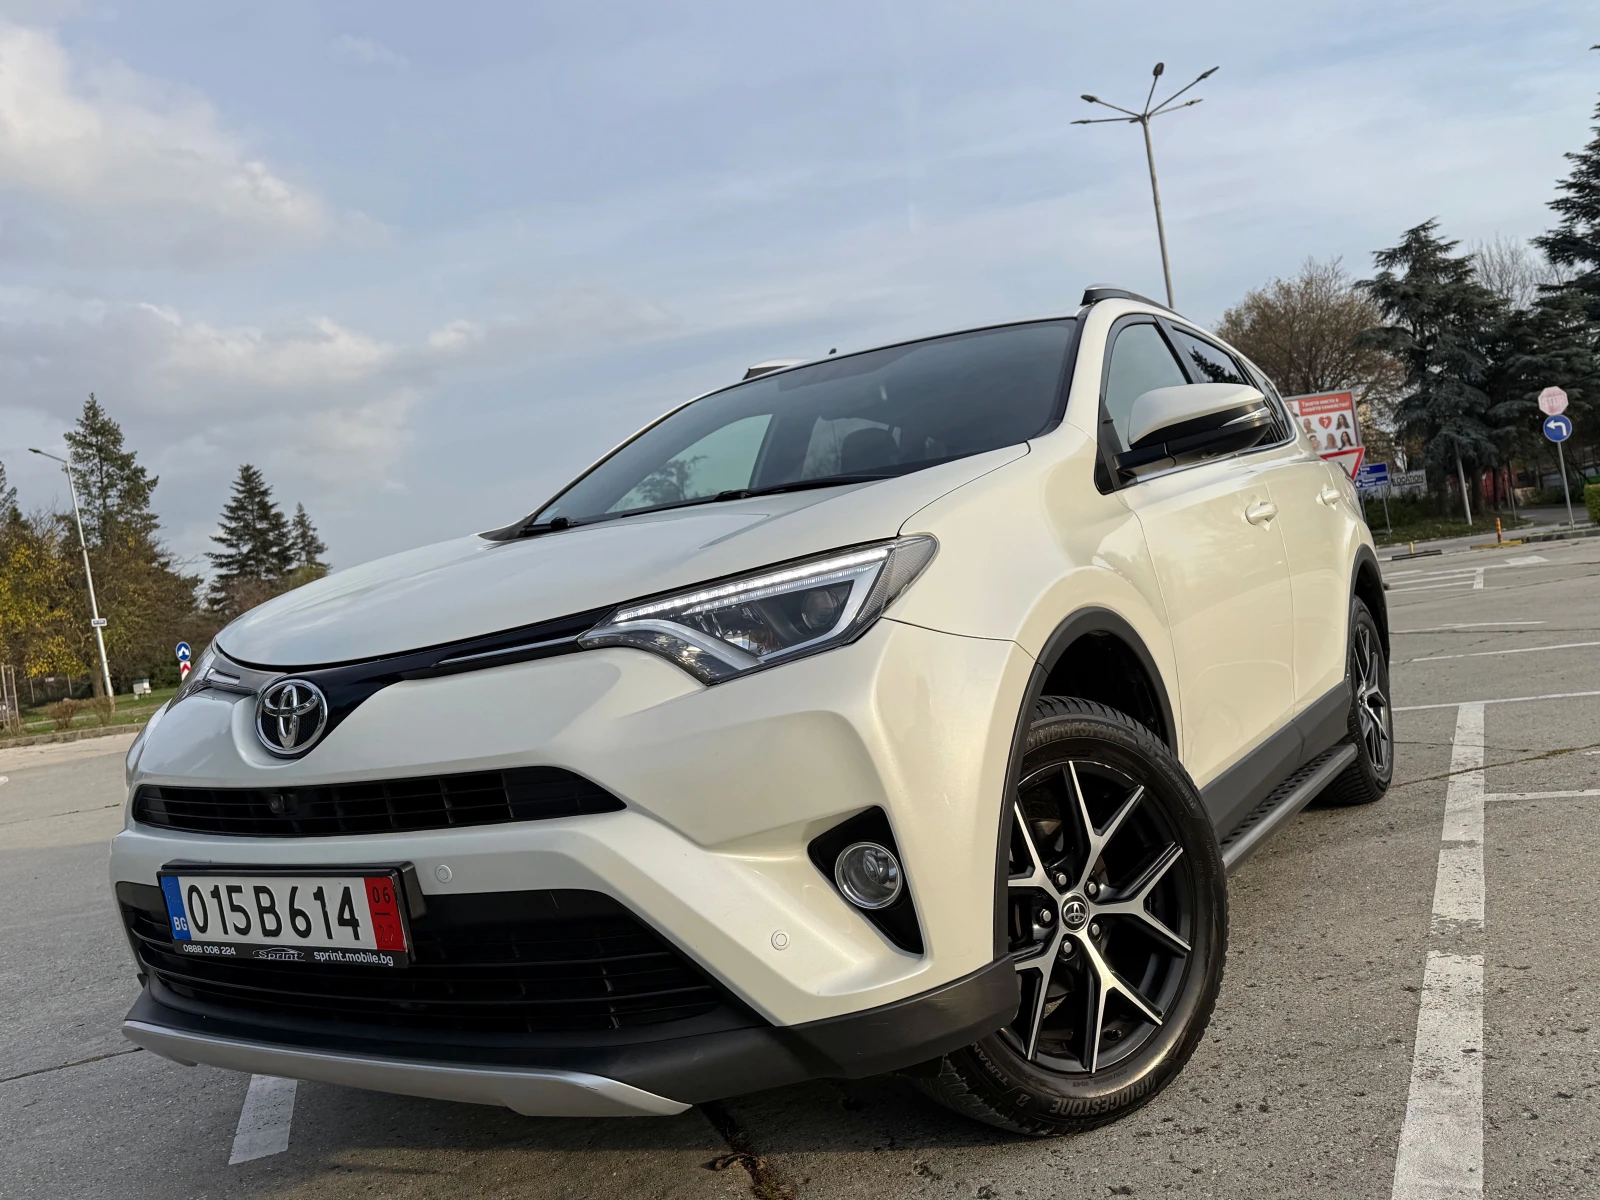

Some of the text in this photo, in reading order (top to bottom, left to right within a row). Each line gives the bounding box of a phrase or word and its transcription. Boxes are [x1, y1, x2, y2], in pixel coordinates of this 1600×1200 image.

[1541, 395, 1564, 408] STOP
[372, 886, 391, 904] 06
[173, 916, 187, 931] BG
[183, 944, 236, 955] 0888 006 224
[313, 950, 394, 967] sprint.mobile.bg
